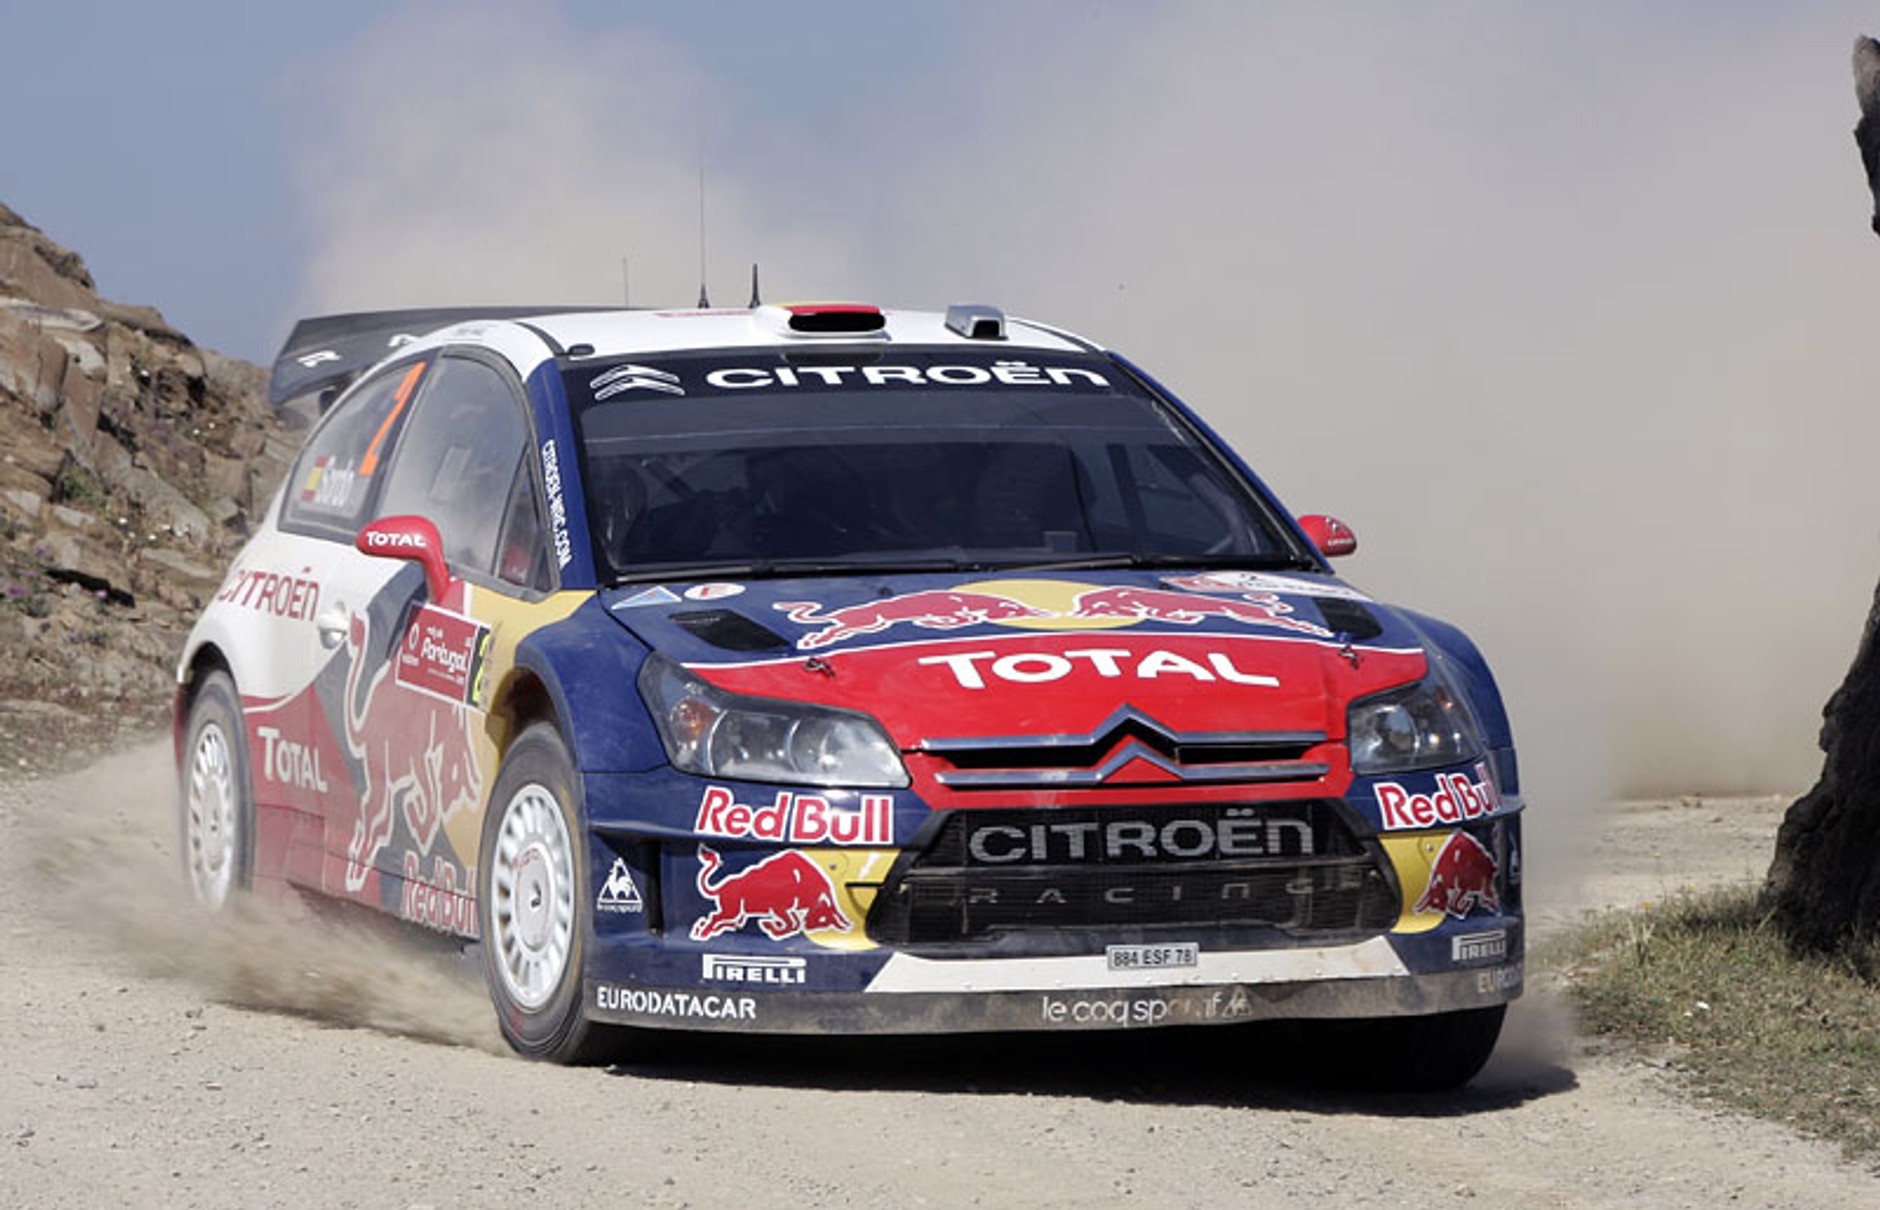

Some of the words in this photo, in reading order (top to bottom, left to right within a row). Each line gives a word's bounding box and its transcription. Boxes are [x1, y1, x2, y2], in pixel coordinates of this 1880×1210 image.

[366, 531, 428, 547] TOTAL
[420, 636, 468, 674] Portugal
[918, 649, 1281, 690] TOTAL
[257, 726, 329, 793] TOTAL
[695, 787, 791, 840] Red
[792, 794, 893, 843] Bull
[1373, 773, 1462, 830] Red
[403, 850, 440, 926] Red
[969, 878, 1314, 904] RACING
[1113, 951, 1139, 967] 884
[1142, 949, 1171, 966] ESF
[1174, 949, 1193, 964] 78
[1452, 929, 1506, 960] PIRELLI
[703, 954, 806, 984] PIRELLI
[597, 987, 757, 1019] EURODATACAR
[1042, 996, 1067, 1021] le
[1071, 999, 1130, 1028] coq
